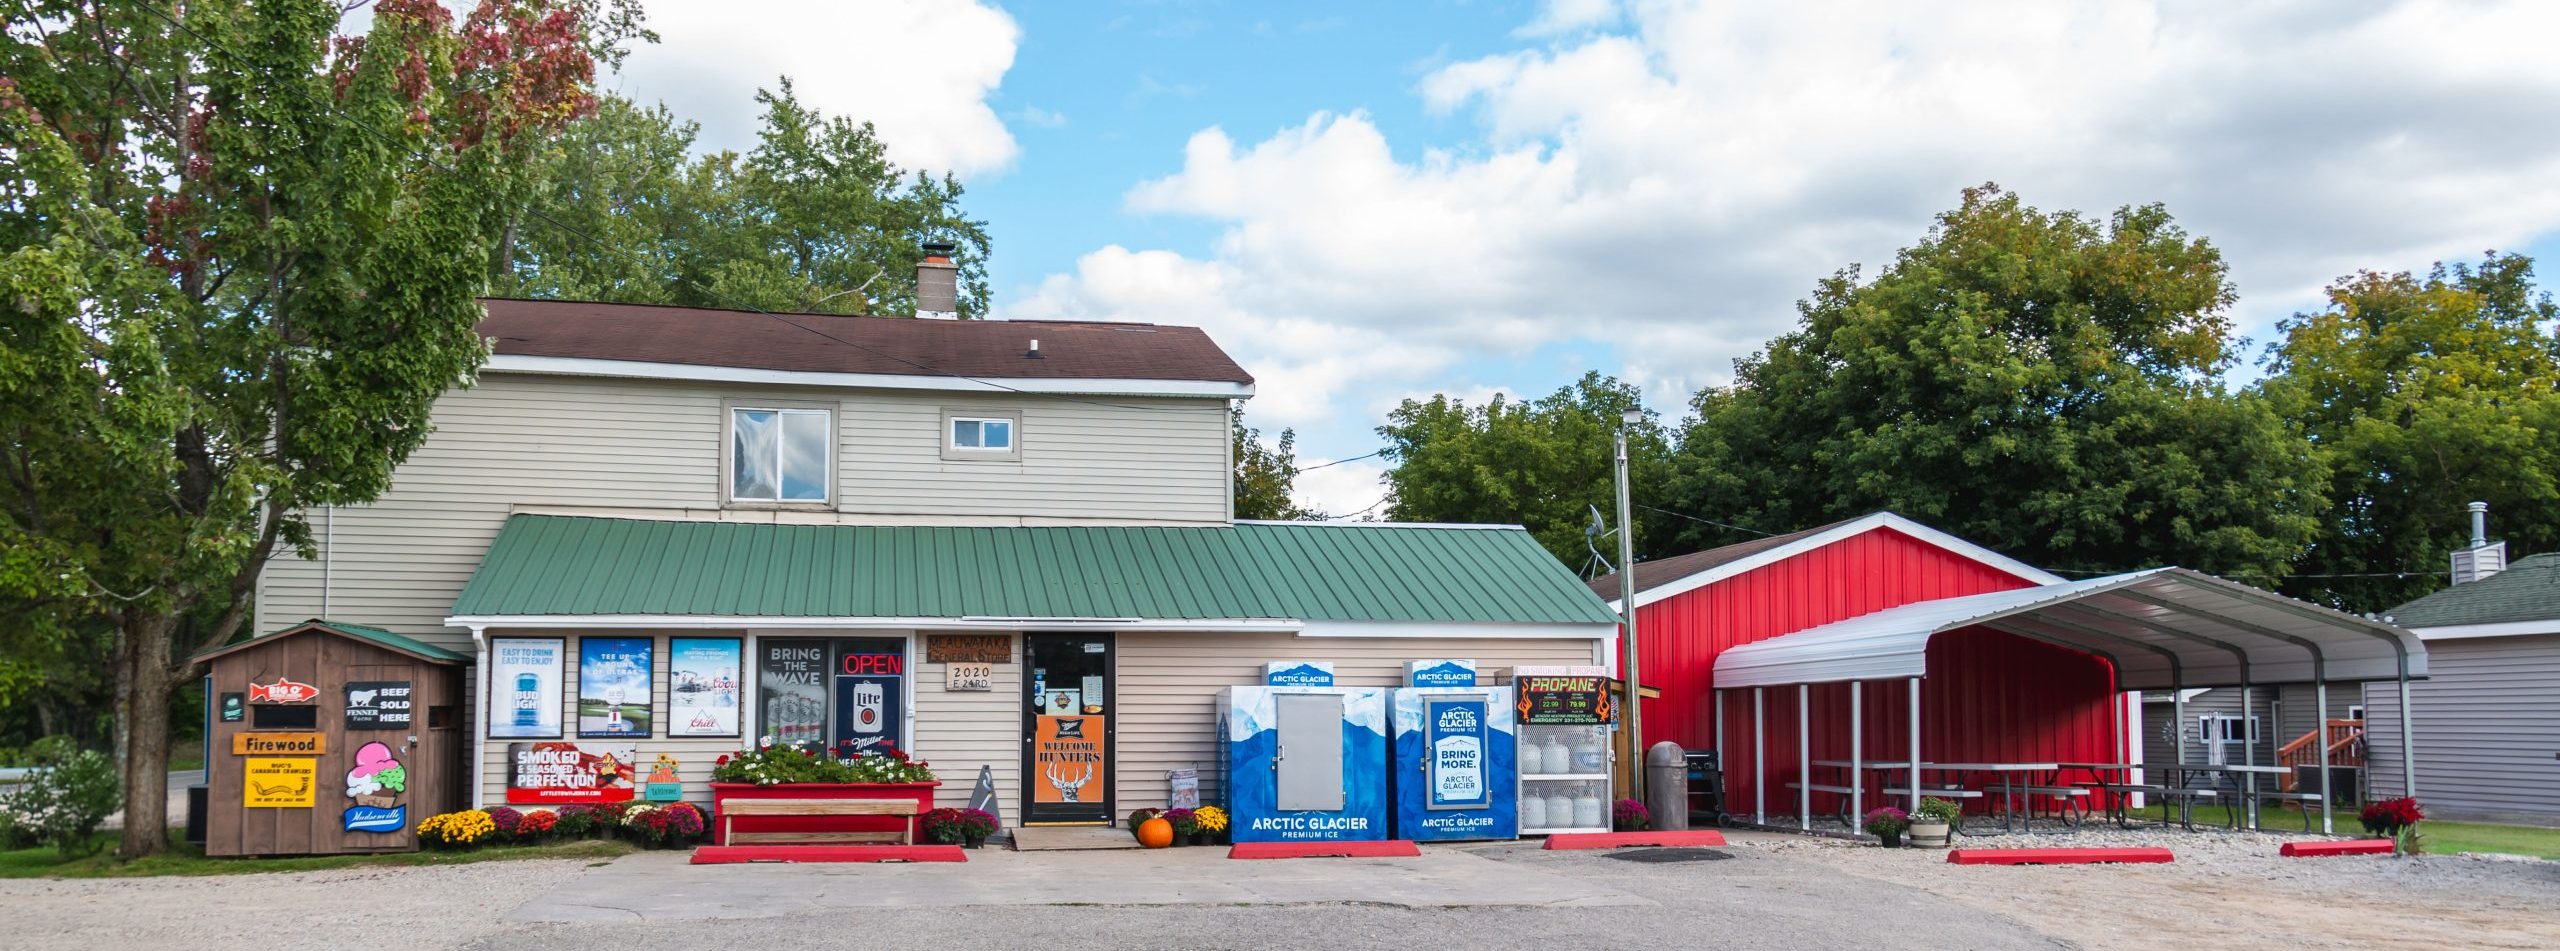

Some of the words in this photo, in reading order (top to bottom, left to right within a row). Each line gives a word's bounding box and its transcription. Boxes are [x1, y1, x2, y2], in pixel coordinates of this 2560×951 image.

[533, 648, 553, 656] DRINK
[771, 648, 820, 660] BRING
[784, 661, 808, 670] THE
[845, 655, 902, 674] OPEN
[954, 667, 989, 677] 2020
[771, 672, 820, 685] WAVE
[1530, 678, 1598, 692] PROPANE
[381, 688, 410, 696] BEEF
[515, 691, 537, 700] BUD
[857, 692, 880, 707] Lite
[380, 701, 410, 709] SOLD
[1441, 711, 1475, 719] ARCTIC
[691, 718, 715, 728] Chill
[246, 737, 315, 750] Firewood
[851, 736, 885, 750] Miller
[1044, 742, 1096, 751] WELCOME
[517, 751, 579, 764] SMOKED
[1039, 752, 1100, 762] HUNTERS
[1441, 751, 1476, 759] BRING
[517, 775, 596, 788] PERFECTION
[1252, 818, 1305, 830] ARCTIC
[1309, 818, 1368, 830] GLACIER
[1422, 819, 1454, 827] ARCTIC
[1457, 818, 1494, 826] GLACIER
